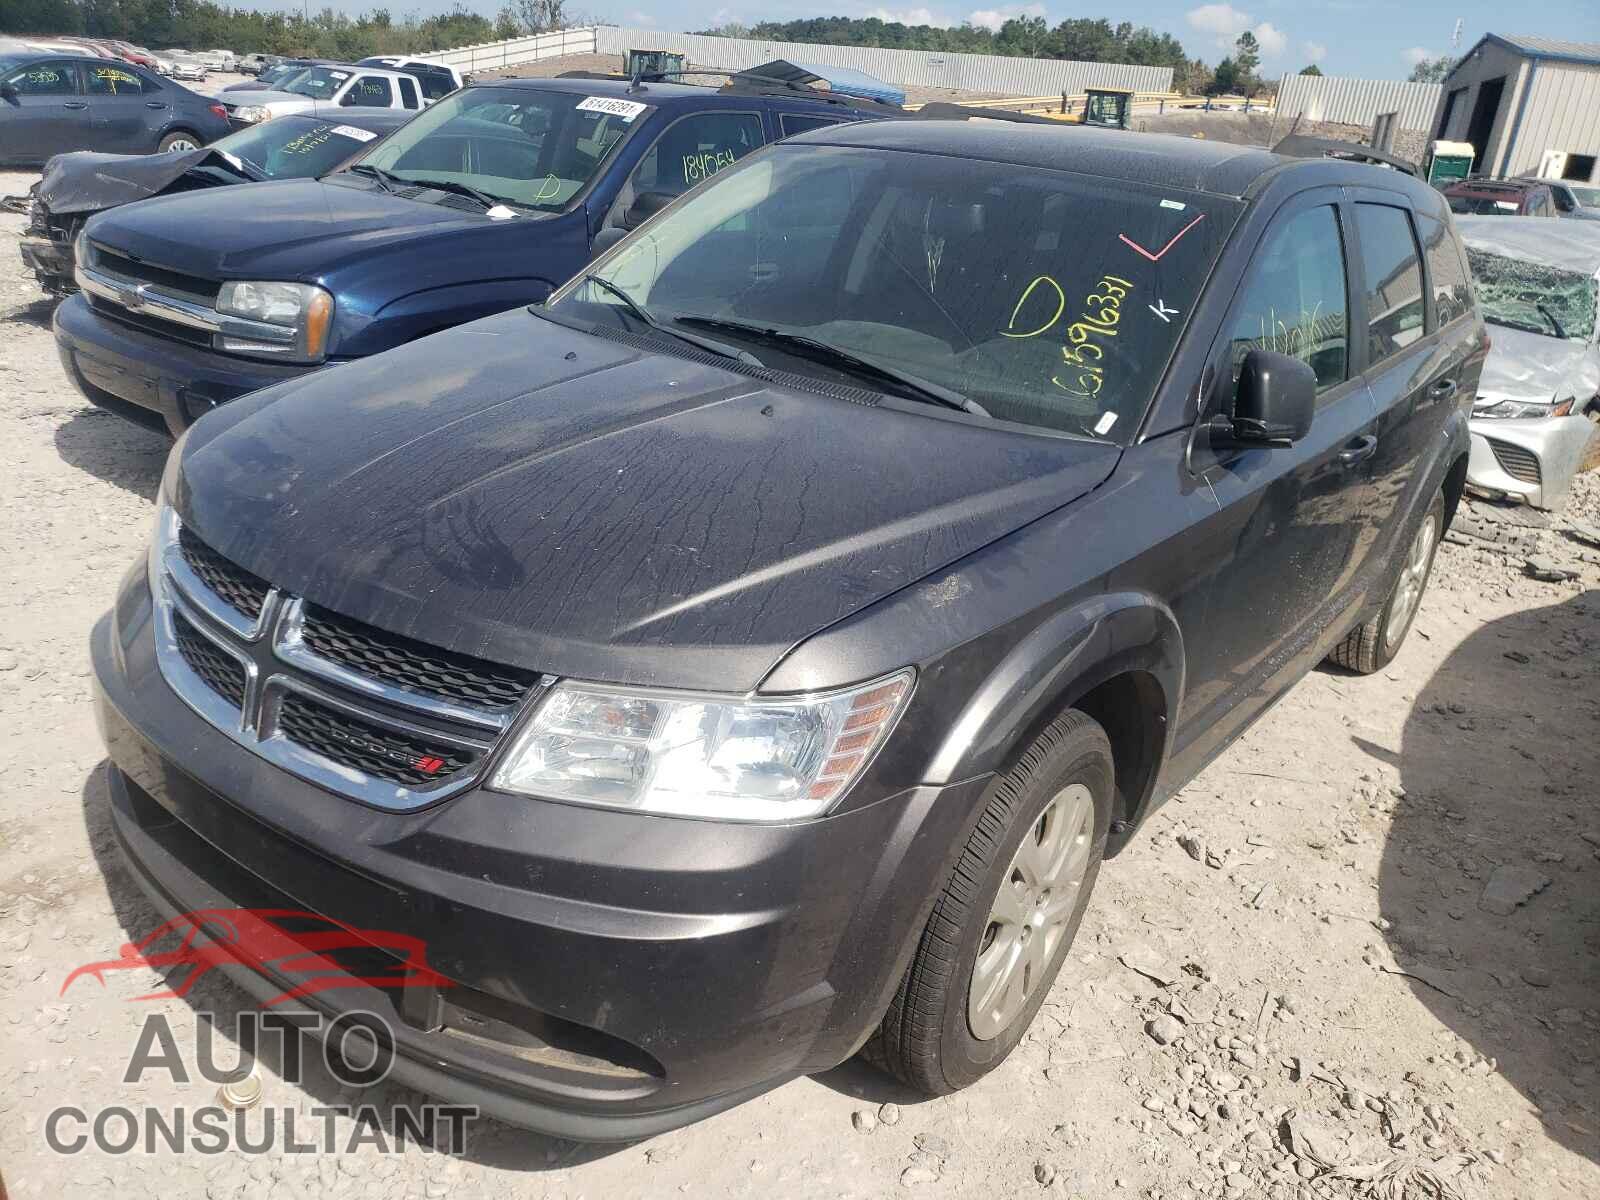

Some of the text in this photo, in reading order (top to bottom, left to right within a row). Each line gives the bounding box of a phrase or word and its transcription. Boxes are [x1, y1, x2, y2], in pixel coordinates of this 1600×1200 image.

[1148, 299, 1180, 323] K
[1052, 275, 1134, 399] 61596331
[331, 728, 428, 768] DODGE
